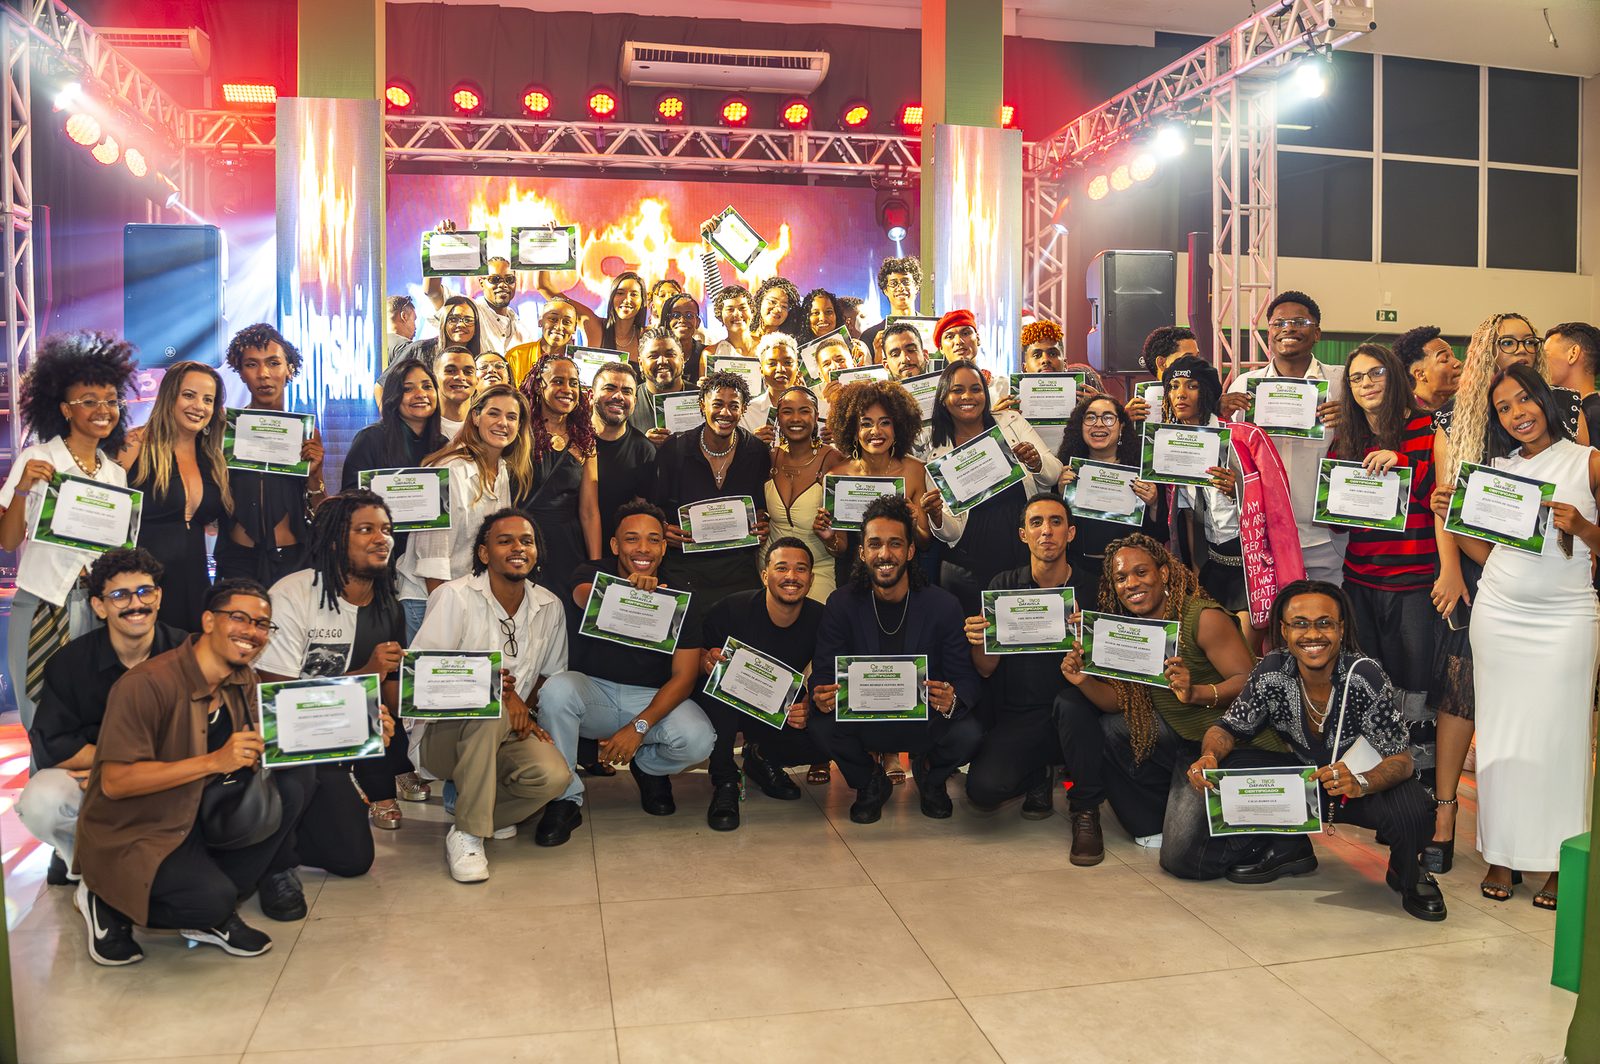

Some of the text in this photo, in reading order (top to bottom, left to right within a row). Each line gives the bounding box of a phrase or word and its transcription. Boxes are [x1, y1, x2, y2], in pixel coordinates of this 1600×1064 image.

[1247, 501, 1260, 514] AM
[1249, 530, 1253, 541] I
[1253, 574, 1274, 588] I WAS
[1260, 598, 1272, 611] TO
